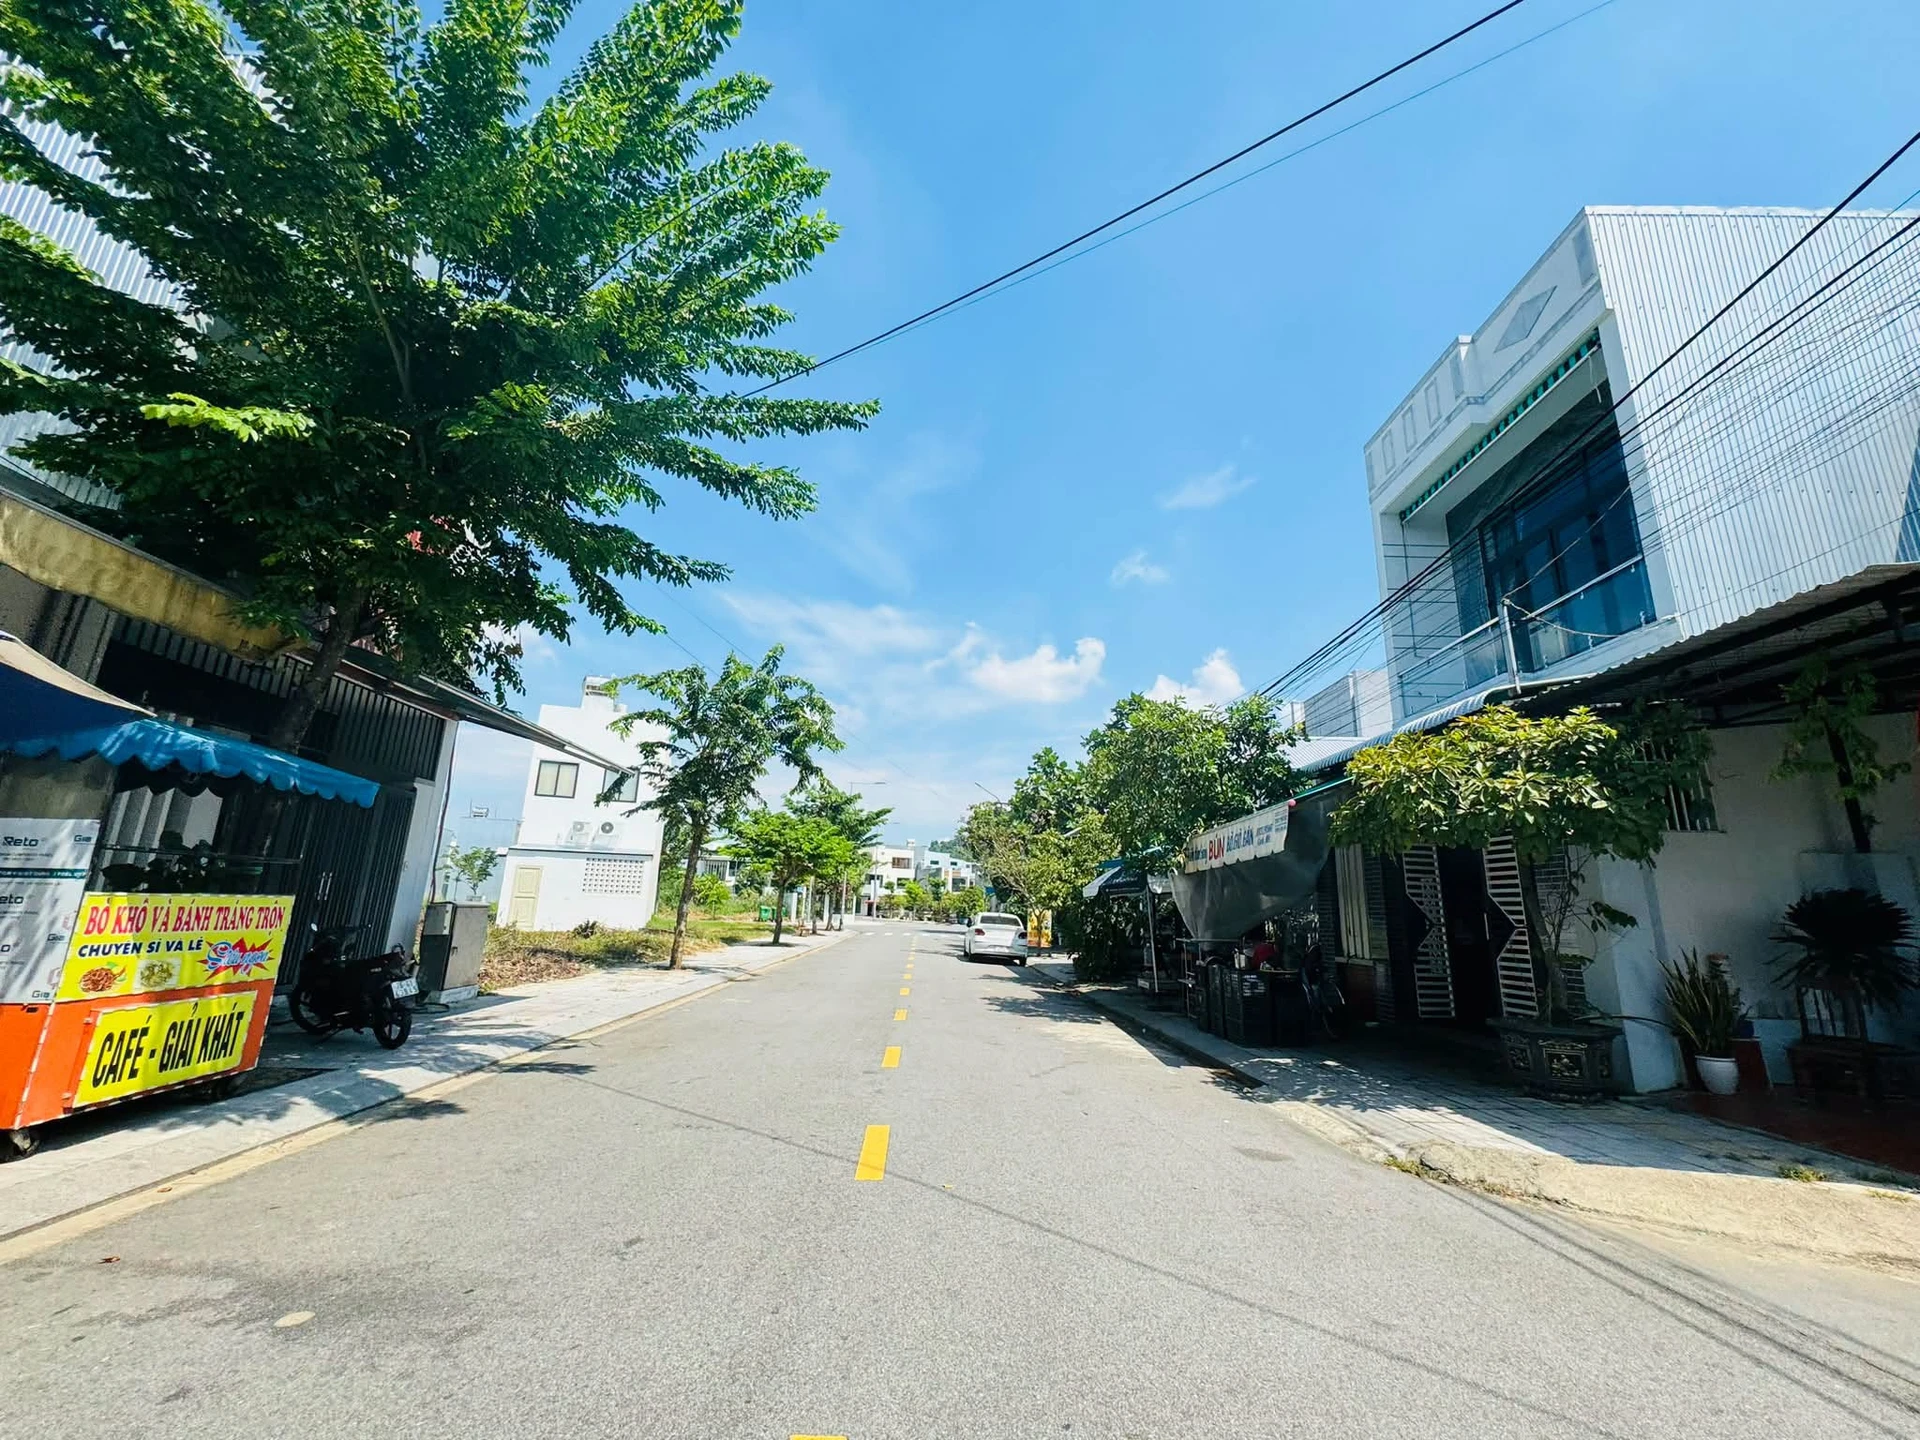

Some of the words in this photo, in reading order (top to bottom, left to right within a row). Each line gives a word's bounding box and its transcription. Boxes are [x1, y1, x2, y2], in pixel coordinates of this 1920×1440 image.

[3, 836, 39, 847] Reto
[0, 893, 24, 905] eto
[84, 898, 111, 935] BÒ
[111, 898, 149, 934] KHÔ
[151, 898, 172, 933] VÀ
[172, 898, 214, 932] BÁNH
[213, 899, 255, 931] TRÁNG
[78, 940, 143, 957] CHUYÊN
[92, 1015, 152, 1088] CAFÉ
[158, 1002, 201, 1073] GIẢI
[197, 1002, 245, 1065] KHÁT
